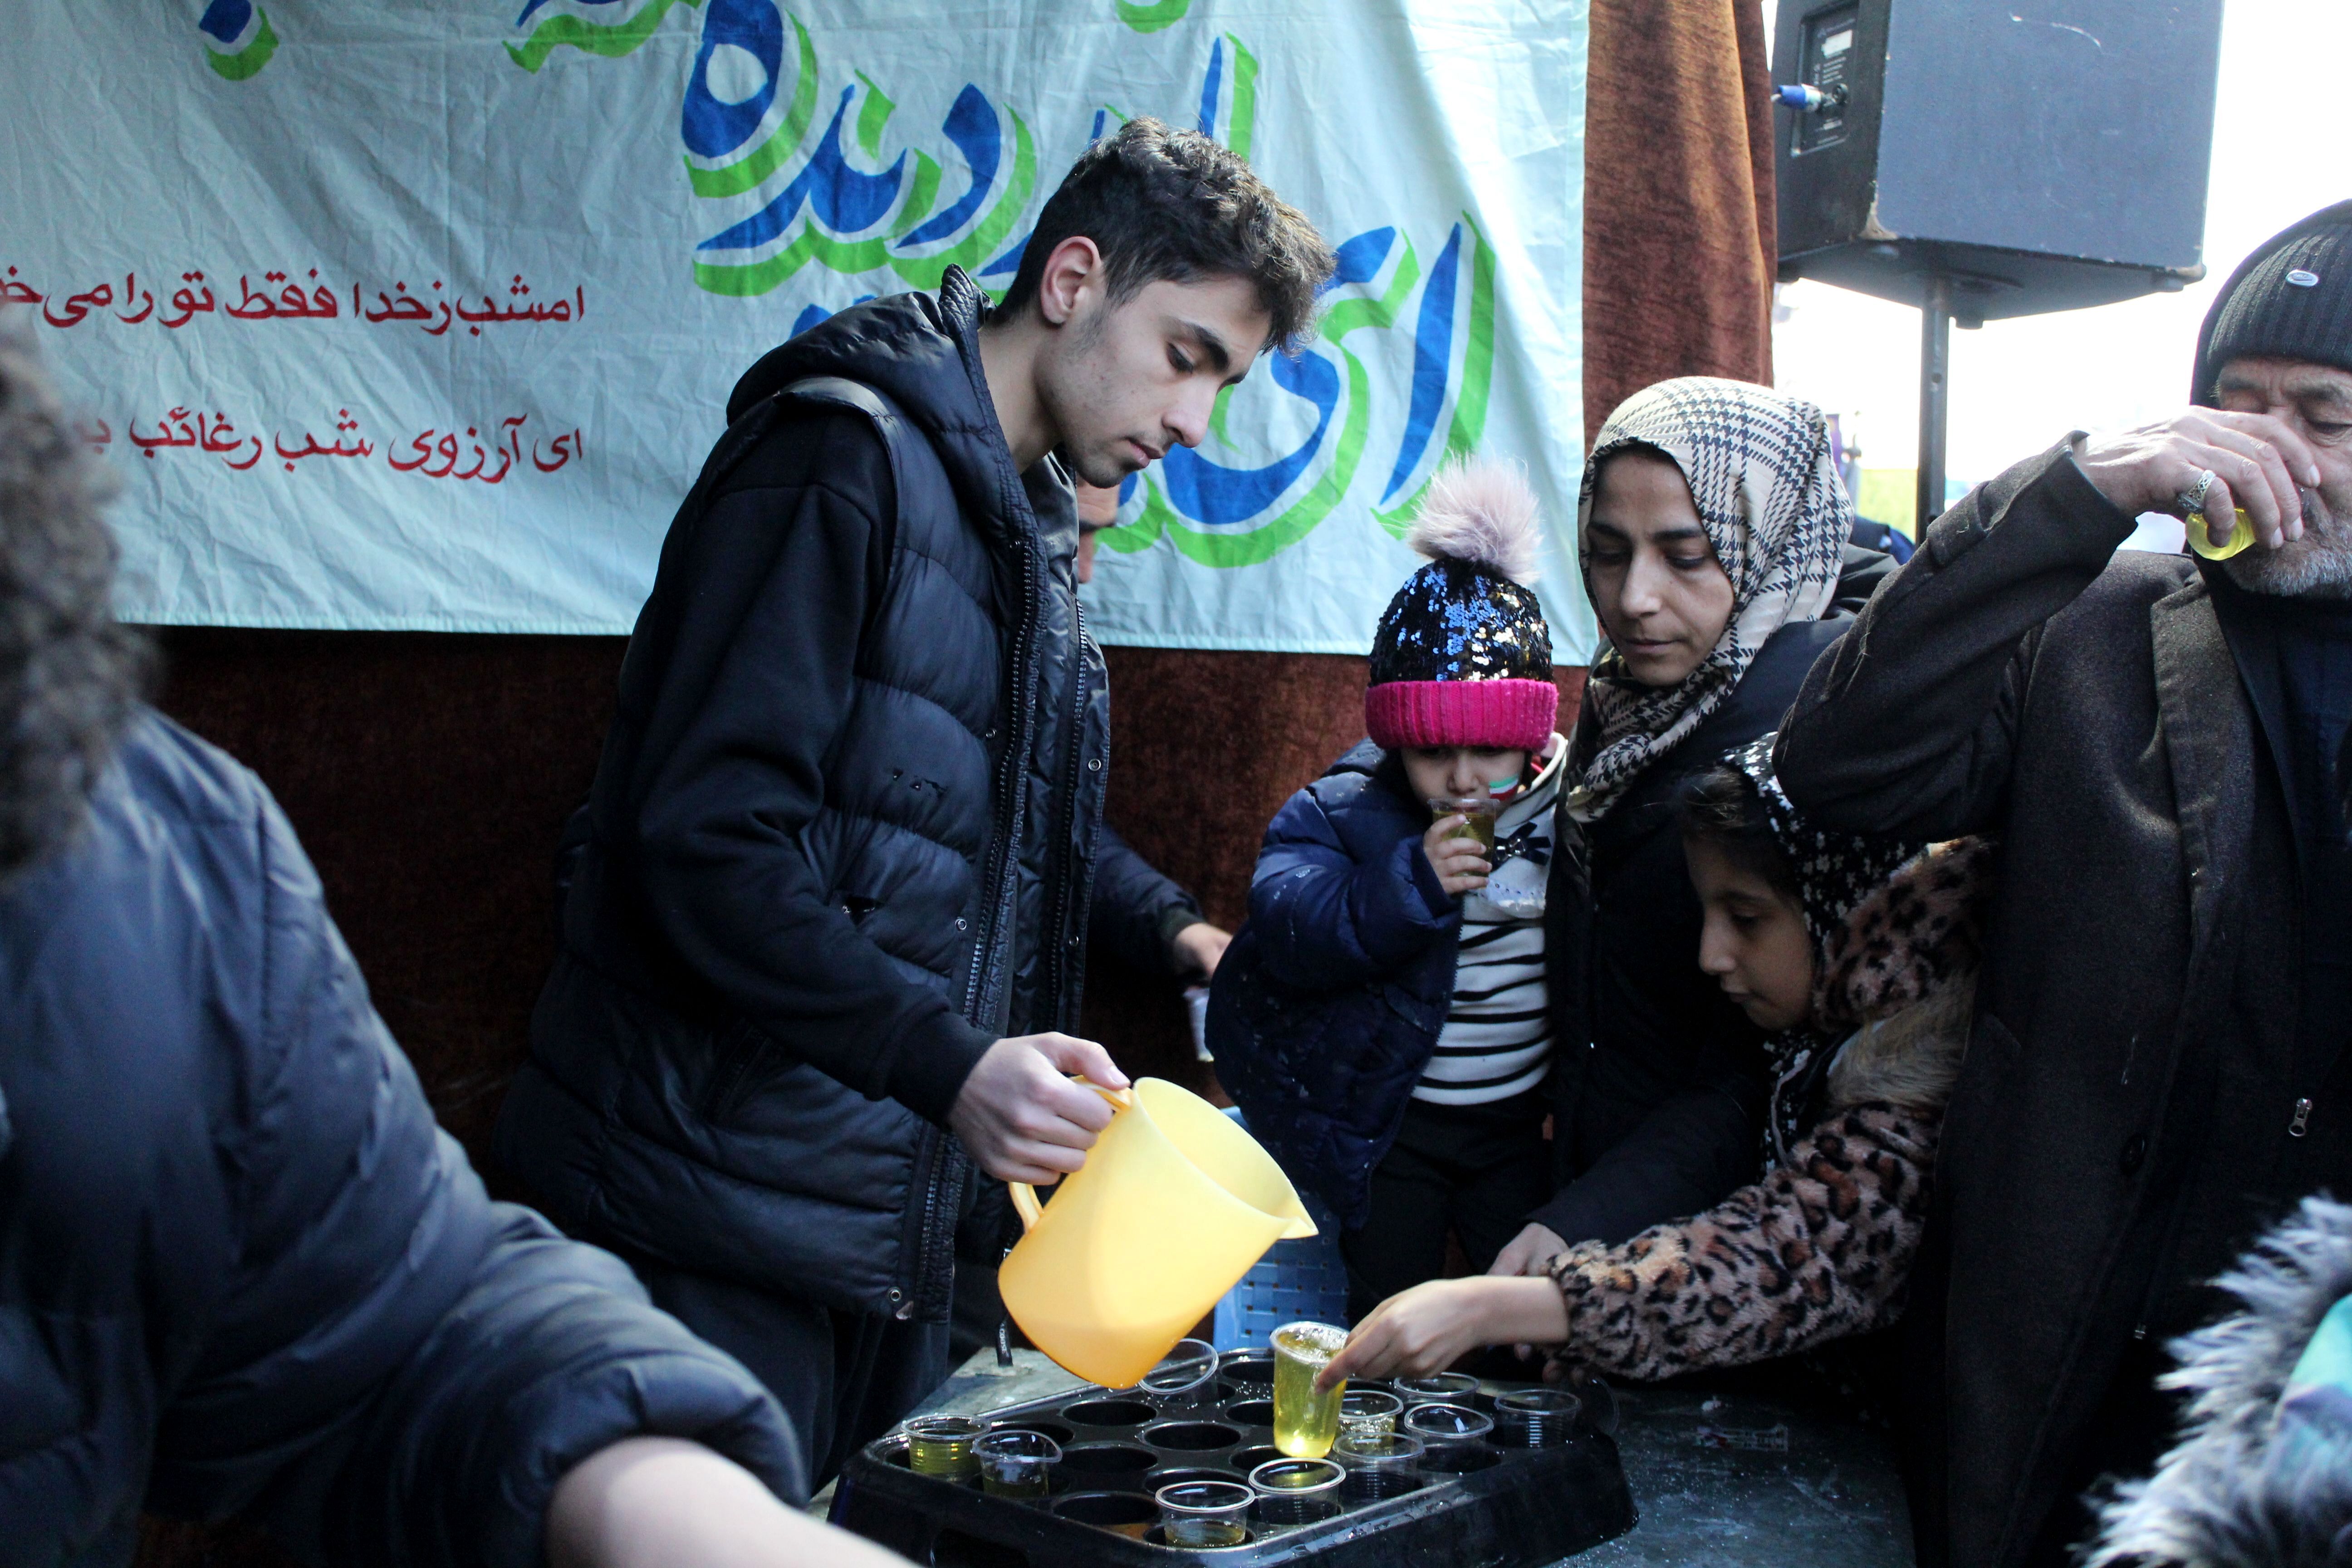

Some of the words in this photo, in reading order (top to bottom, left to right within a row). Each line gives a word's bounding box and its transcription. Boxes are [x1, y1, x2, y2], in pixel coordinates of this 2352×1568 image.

[114, 272, 153, 324] را
[157, 271, 215, 328] تو
[225, 268, 338, 320] فقط
[456, 274, 584, 337] امشب
[129, 406, 262, 470] رغائب
[274, 408, 374, 472] شب
[387, 412, 528, 484] آرزوی
[532, 428, 583, 472] ای
